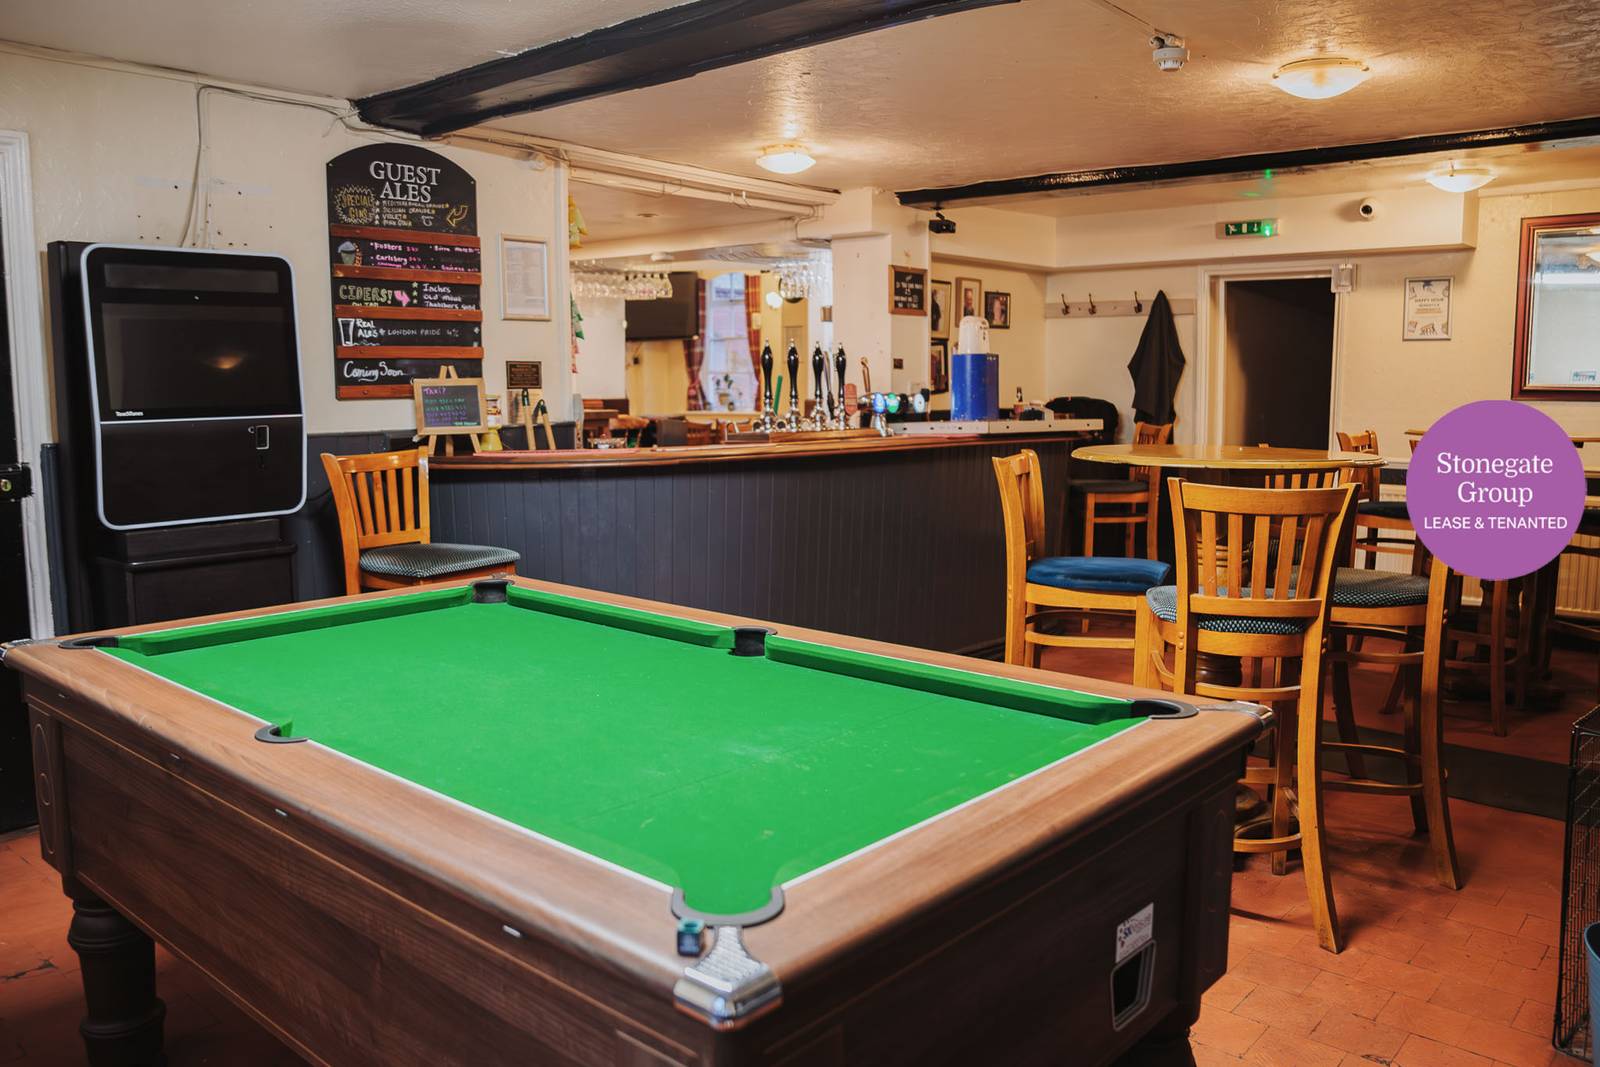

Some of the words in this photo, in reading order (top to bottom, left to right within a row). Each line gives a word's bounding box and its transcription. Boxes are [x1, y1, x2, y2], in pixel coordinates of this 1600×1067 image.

[369, 160, 441, 186] GUEST
[379, 181, 432, 204] ALES
[422, 283, 451, 294] Inches
[420, 328, 441, 336] PRIDE
[343, 360, 379, 382] Coming
[379, 361, 405, 376] Soon
